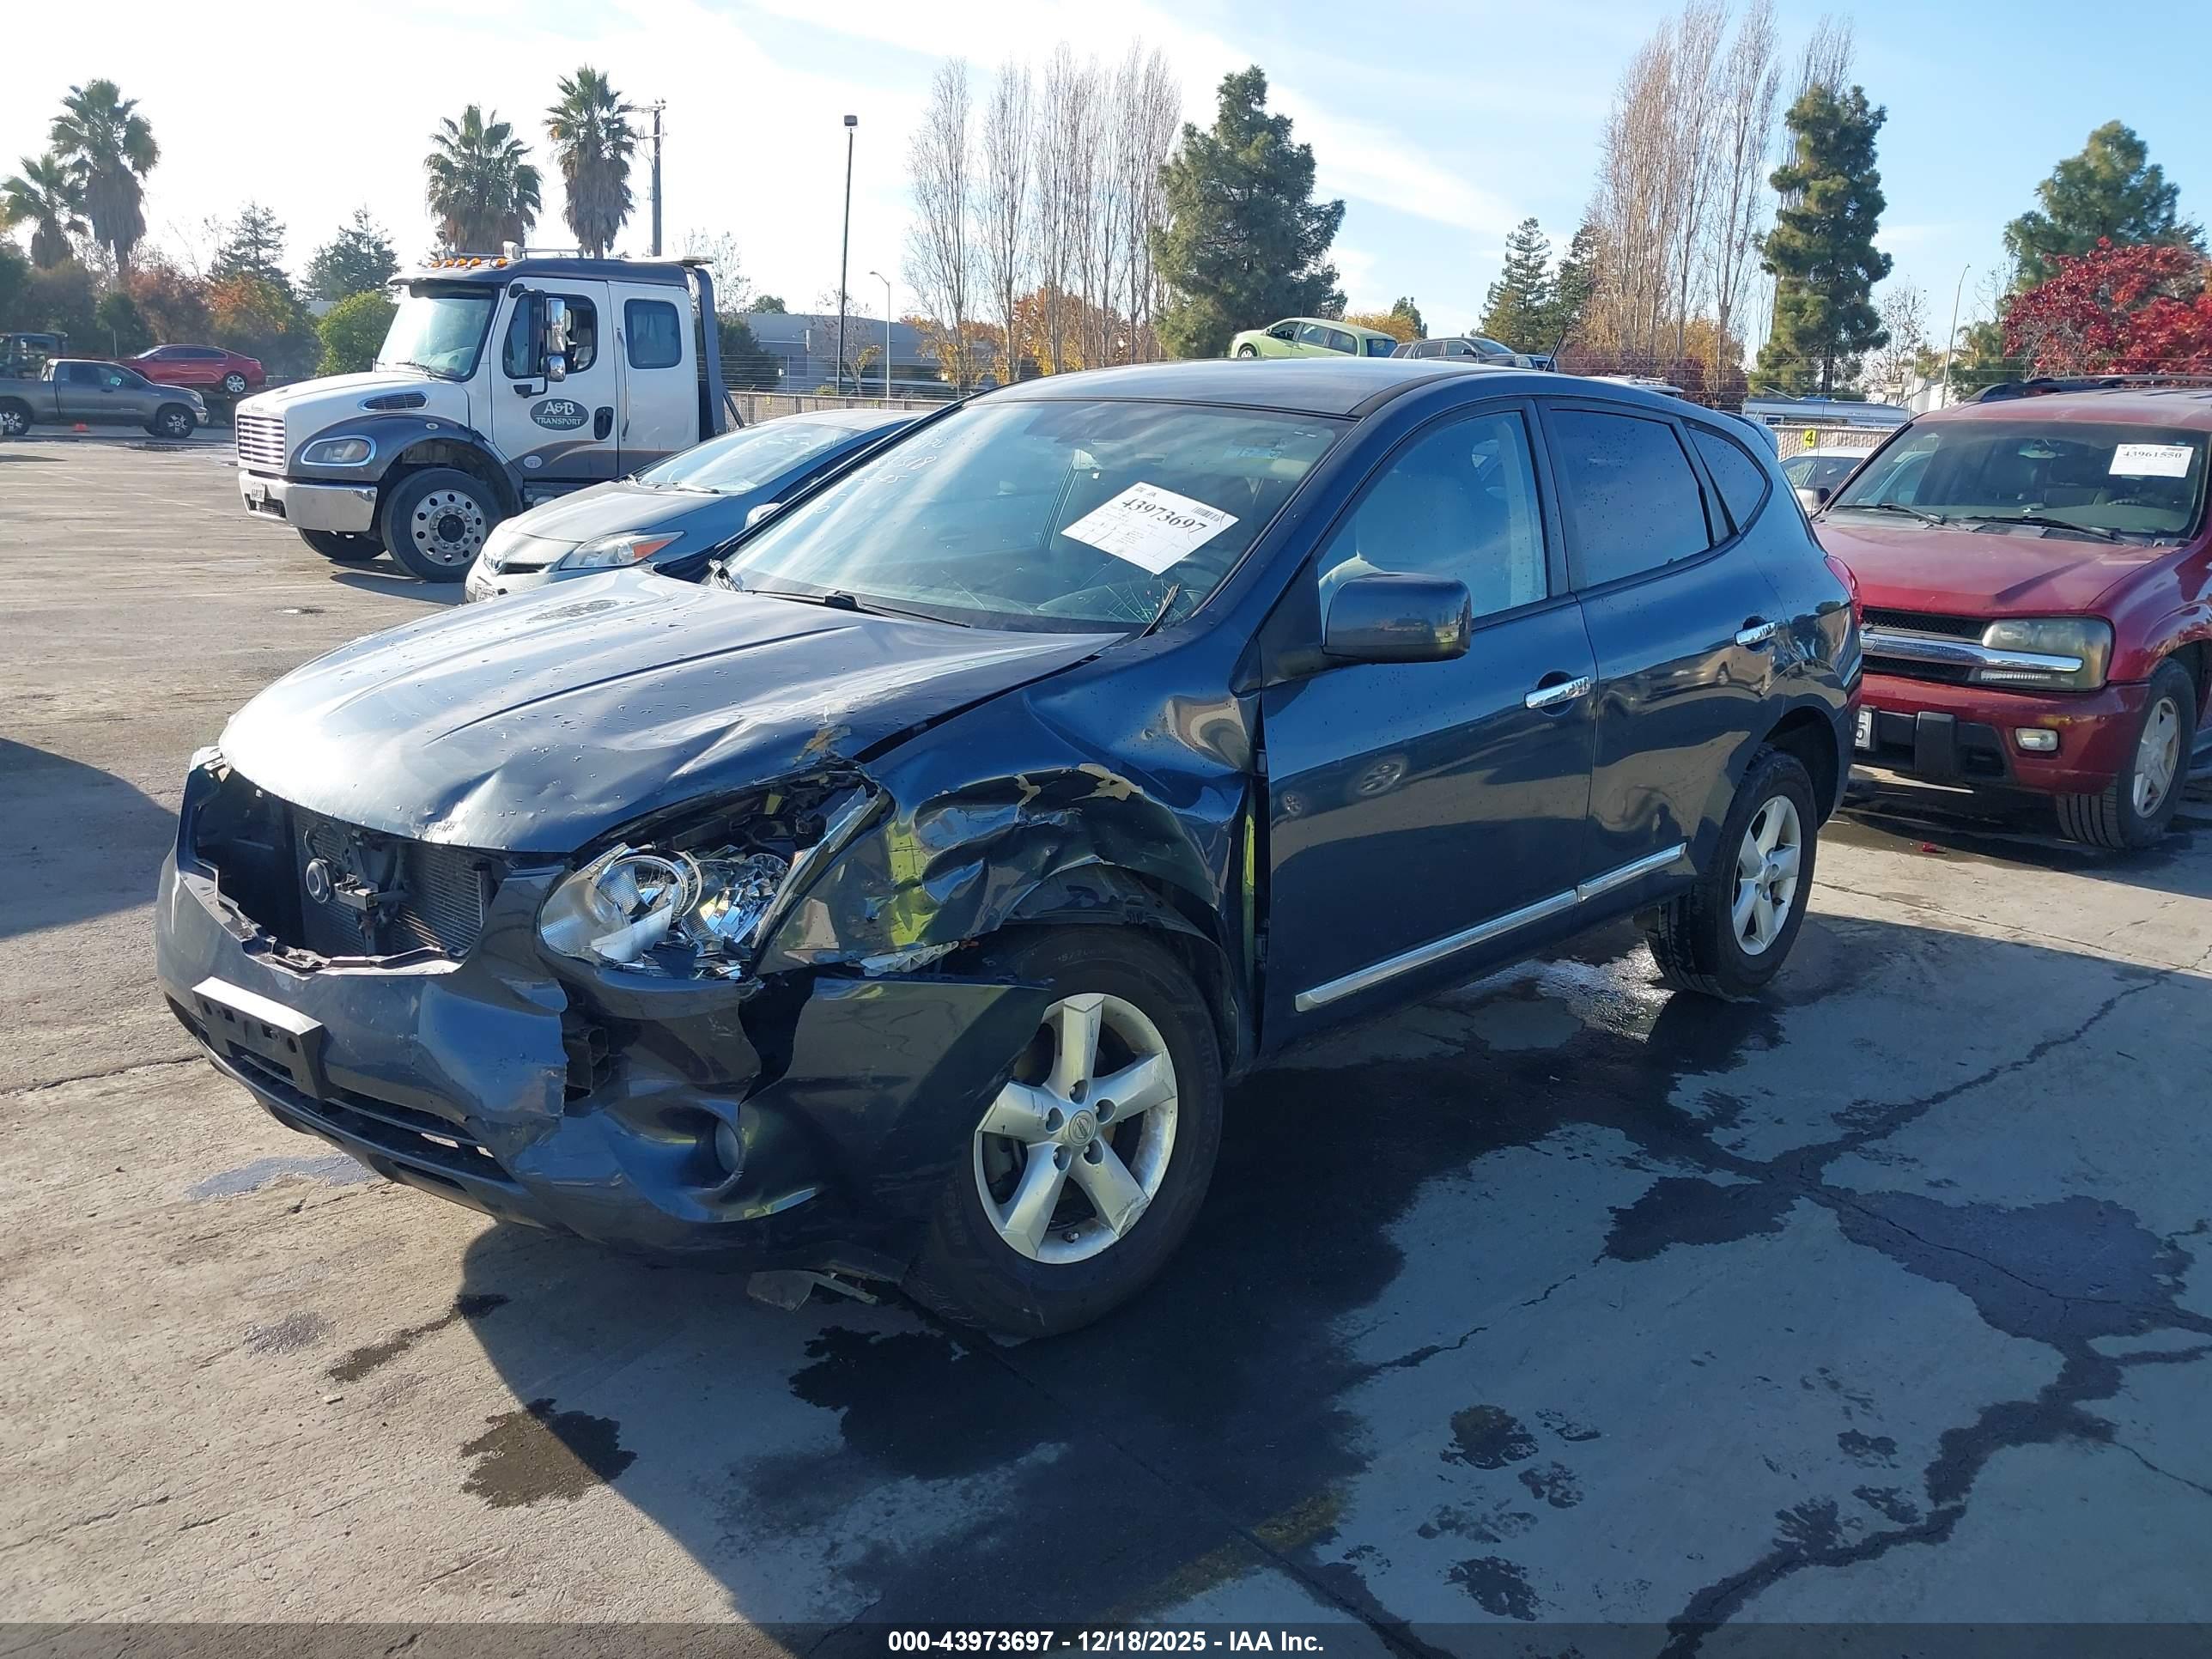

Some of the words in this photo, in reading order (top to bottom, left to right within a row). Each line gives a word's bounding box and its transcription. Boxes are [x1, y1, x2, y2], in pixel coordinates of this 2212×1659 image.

[544, 401, 574, 415] A&B
[1806, 431, 1814, 444] 4
[1122, 499, 1208, 533] 43973697
